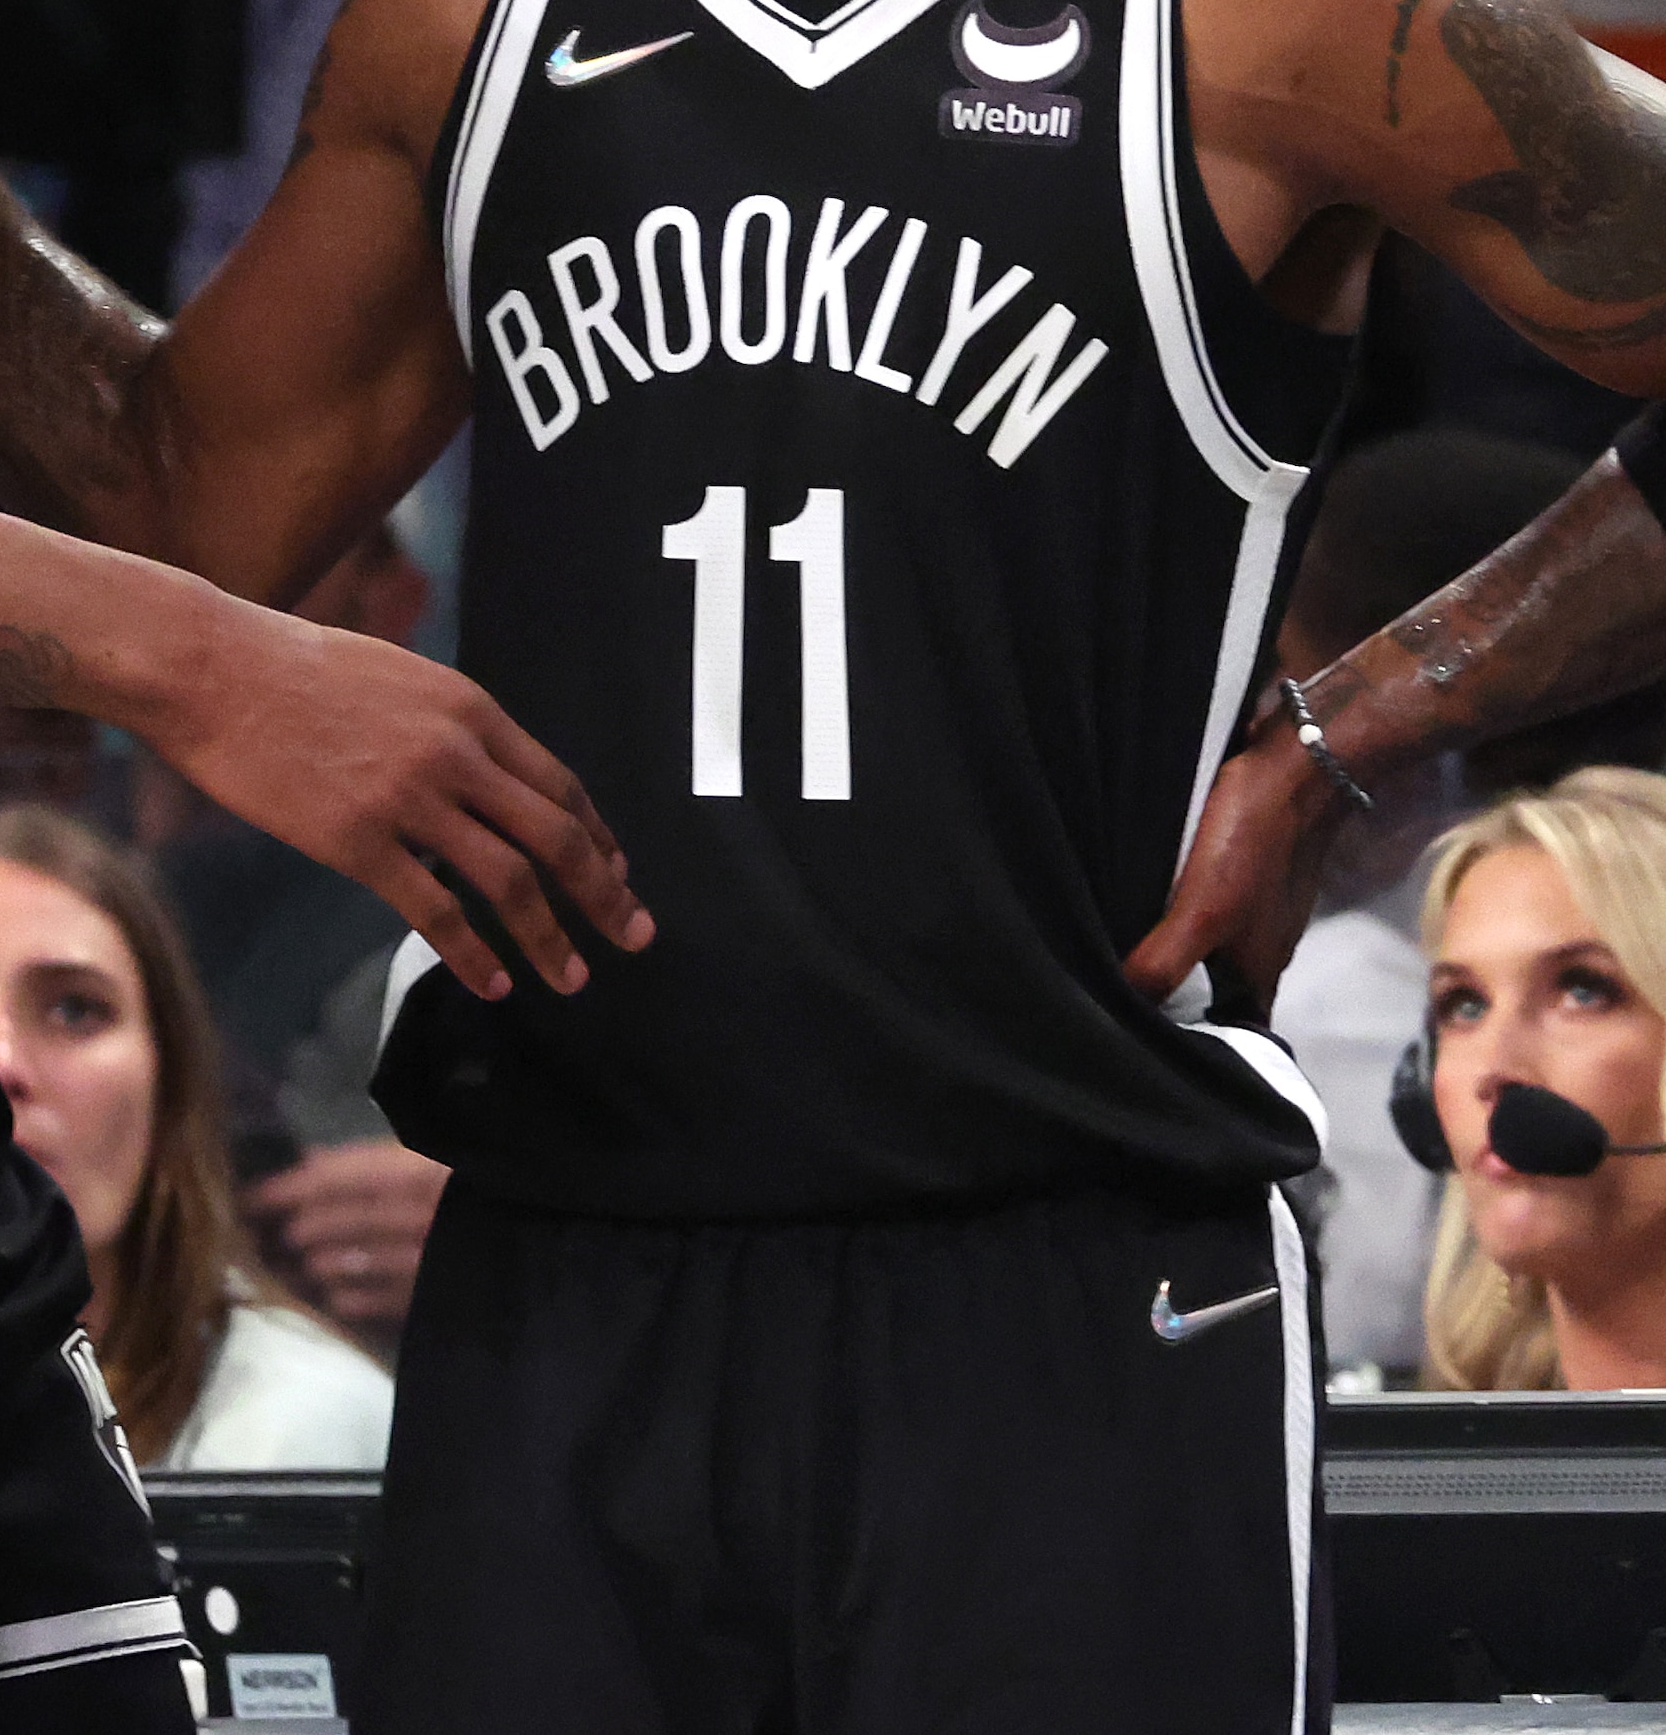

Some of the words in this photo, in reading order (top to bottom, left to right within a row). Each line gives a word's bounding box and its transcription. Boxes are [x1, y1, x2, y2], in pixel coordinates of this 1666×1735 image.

[951, 99, 1072, 139] Webull
[486, 194, 1110, 469] BROOKLYN
[661, 485, 852, 801] 11
